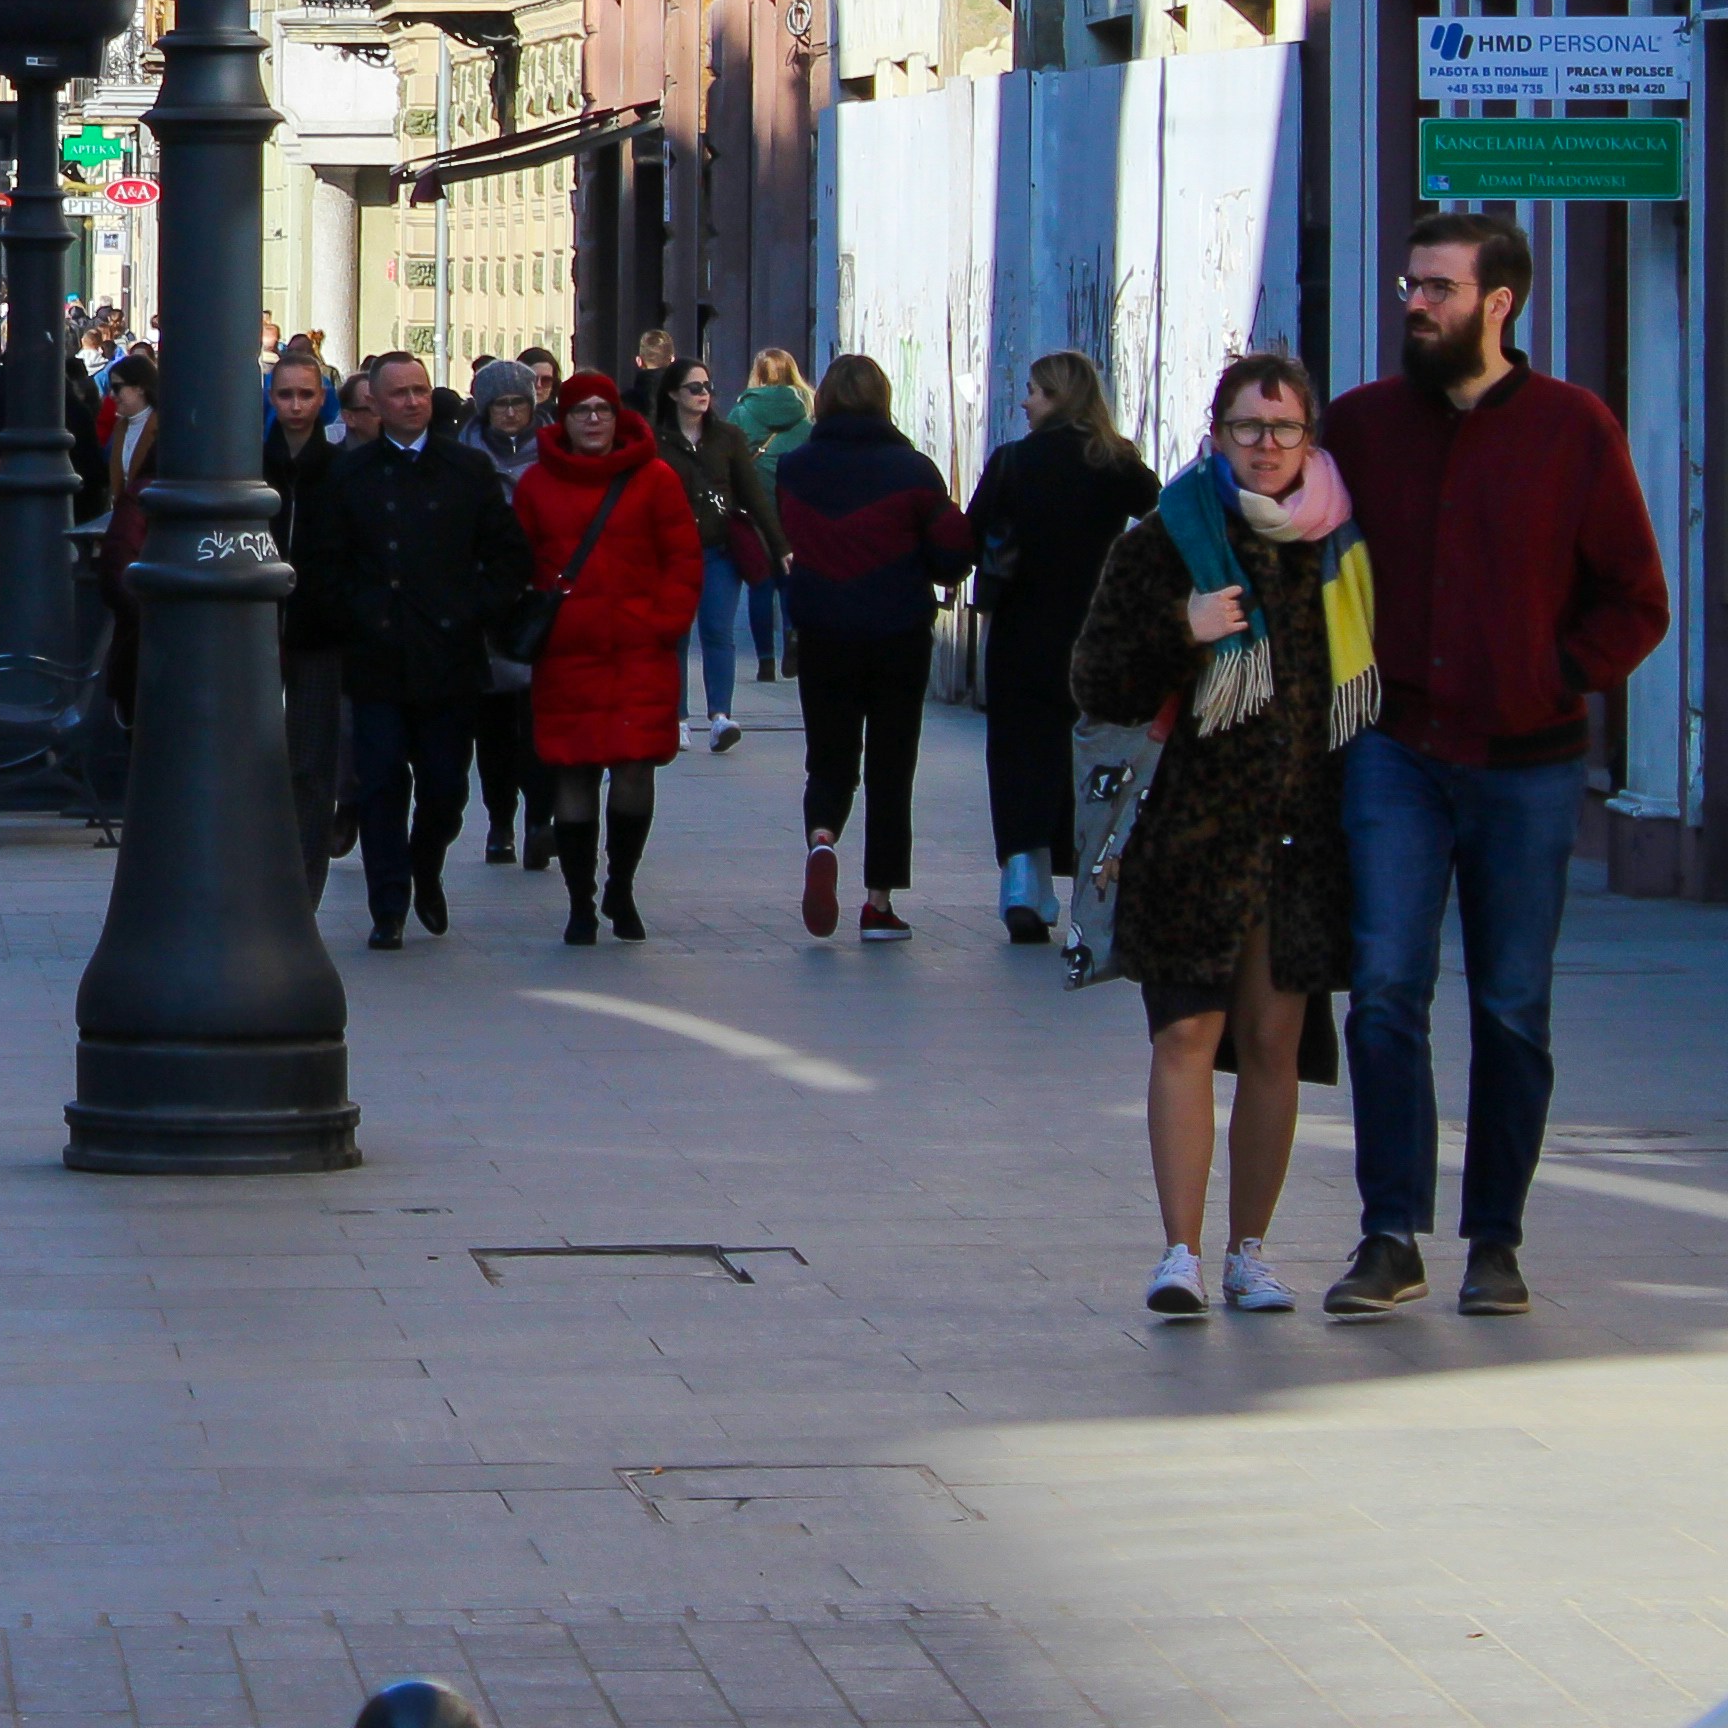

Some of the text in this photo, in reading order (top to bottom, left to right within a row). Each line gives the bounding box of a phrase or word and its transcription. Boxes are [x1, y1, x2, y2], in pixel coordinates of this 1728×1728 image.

[1478, 34, 1660, 53] HMD PERSONAL
[1429, 66, 1480, 77] РАБОТА
[1494, 66, 1549, 77] ПОЛЬШЕ
[1566, 66, 1674, 78] PRACA W POLSCE
[1446, 83, 1544, 95] +48 533 894 735
[1568, 83, 1666, 95] +48 533 894 420
[70, 144, 116, 155] APTEKA
[1434, 134, 1668, 152] KANCELARIA ADWOKACKA
[1477, 174, 1627, 188] ADAM PARADOWSKI
[113, 184, 152, 200] A&A
[63, 198, 125, 213] PTEKA
